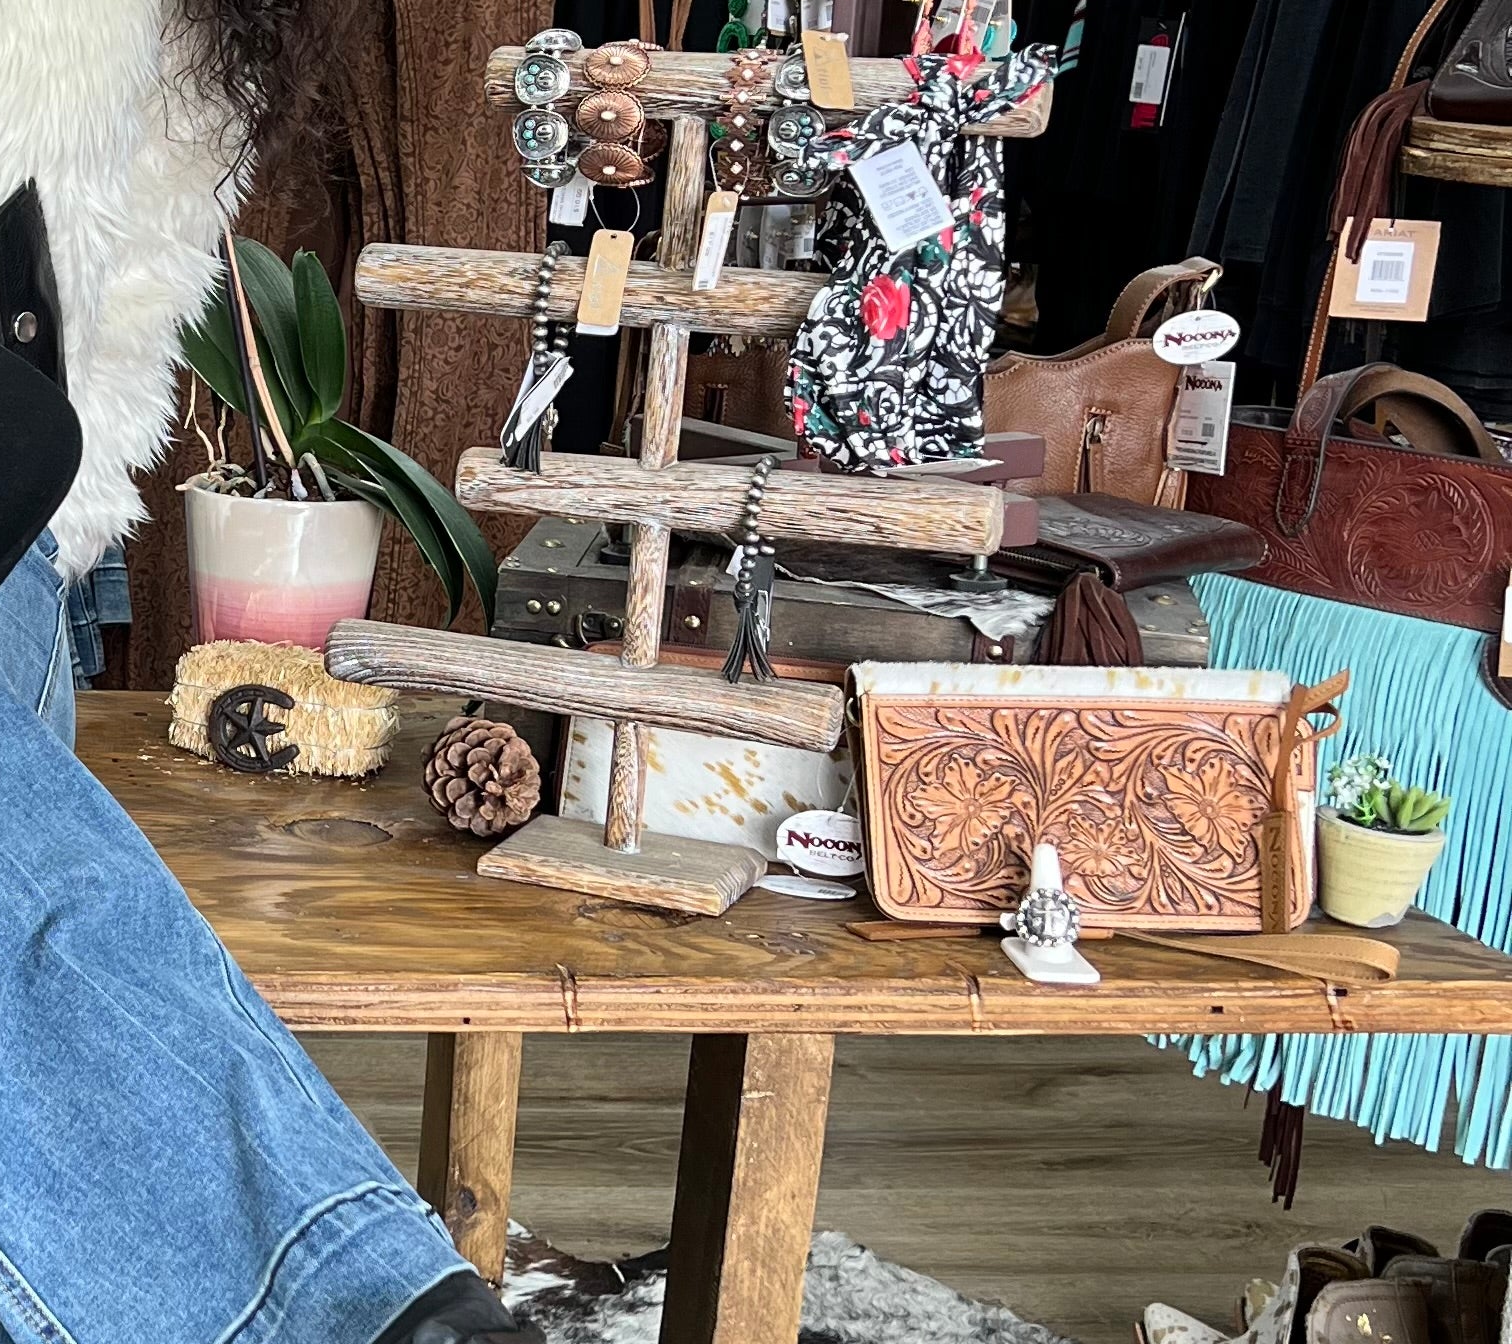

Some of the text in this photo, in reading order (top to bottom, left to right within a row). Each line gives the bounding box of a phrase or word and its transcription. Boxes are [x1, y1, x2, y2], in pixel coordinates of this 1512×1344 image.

[1373, 228, 1417, 238] ARIAT
[1163, 329, 1236, 348] NOCONA
[1185, 374, 1223, 392] NOCONA
